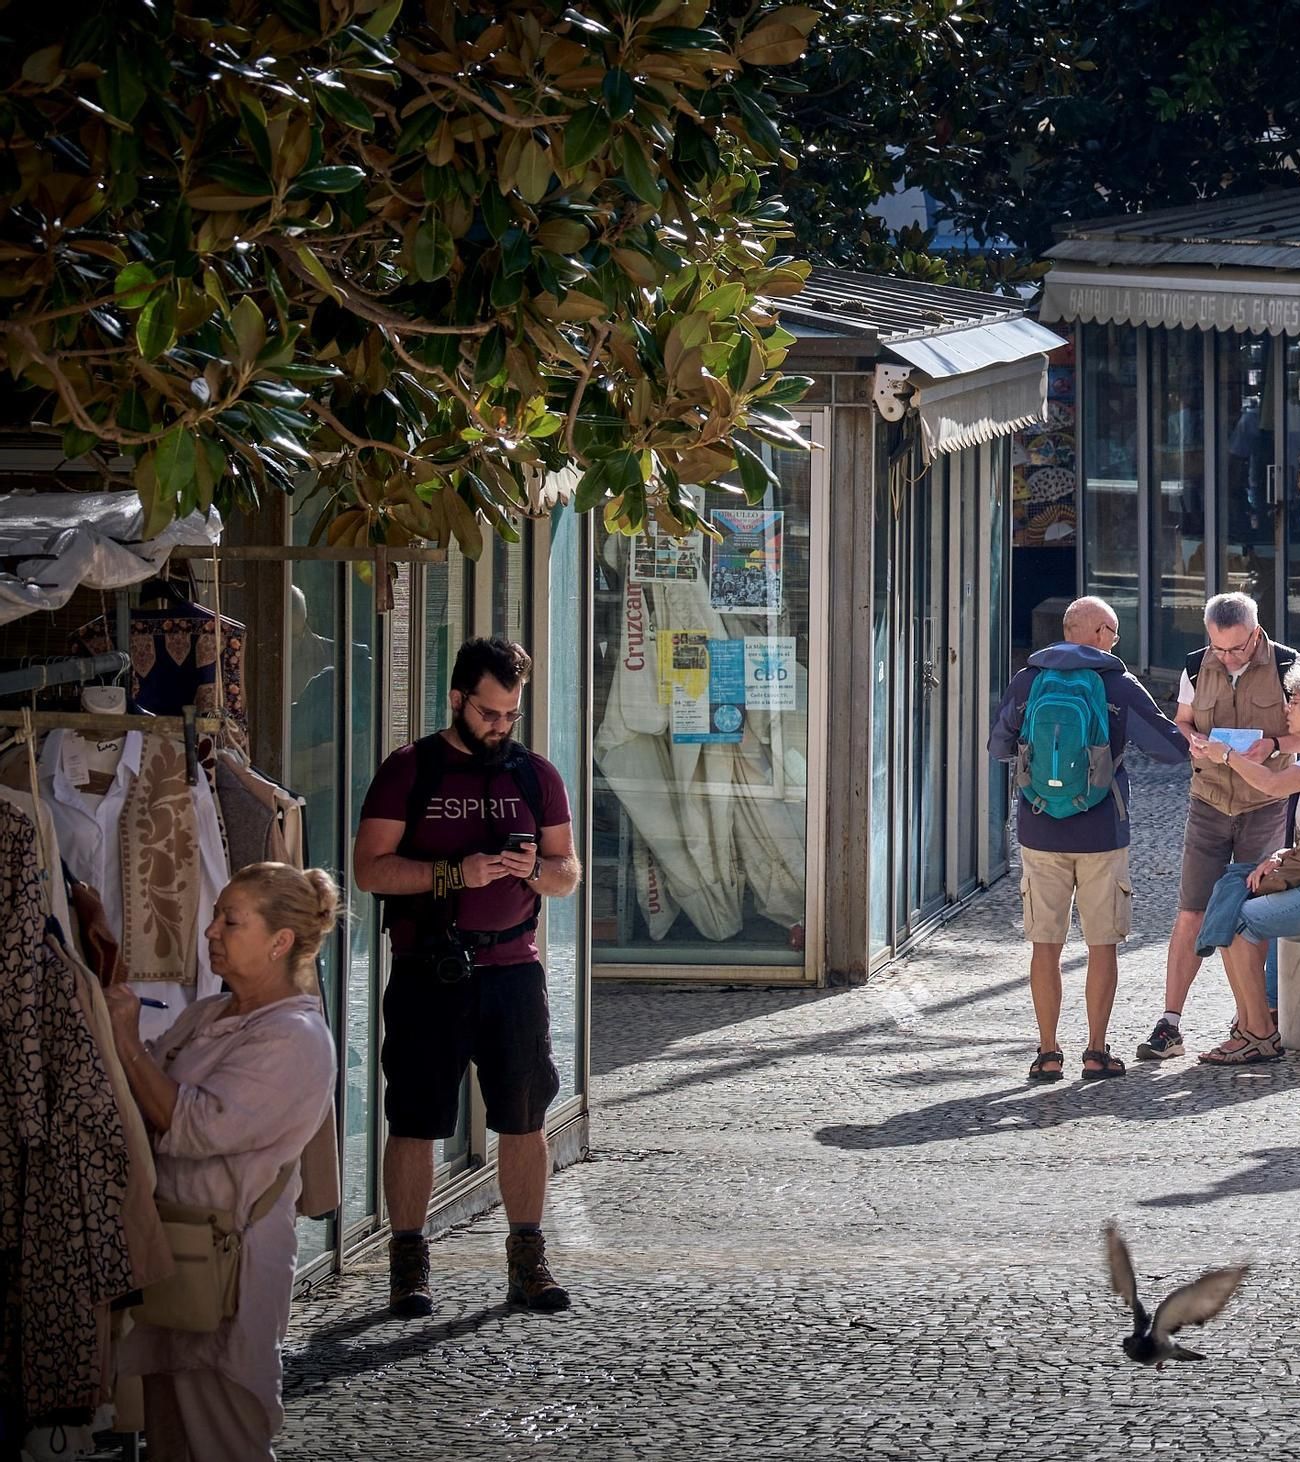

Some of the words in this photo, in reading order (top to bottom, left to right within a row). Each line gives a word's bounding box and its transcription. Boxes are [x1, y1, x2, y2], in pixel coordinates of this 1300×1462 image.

[1116, 290, 1131, 315] LA
[1138, 291, 1195, 318] BOUTIQUE
[1200, 295, 1216, 321] DE
[1223, 297, 1245, 323] LAS
[1252, 299, 1299, 326] FLORES
[624, 556, 646, 671] Cruzcam
[754, 668, 788, 681] CBD
[425, 798, 520, 819] ESPRIT
